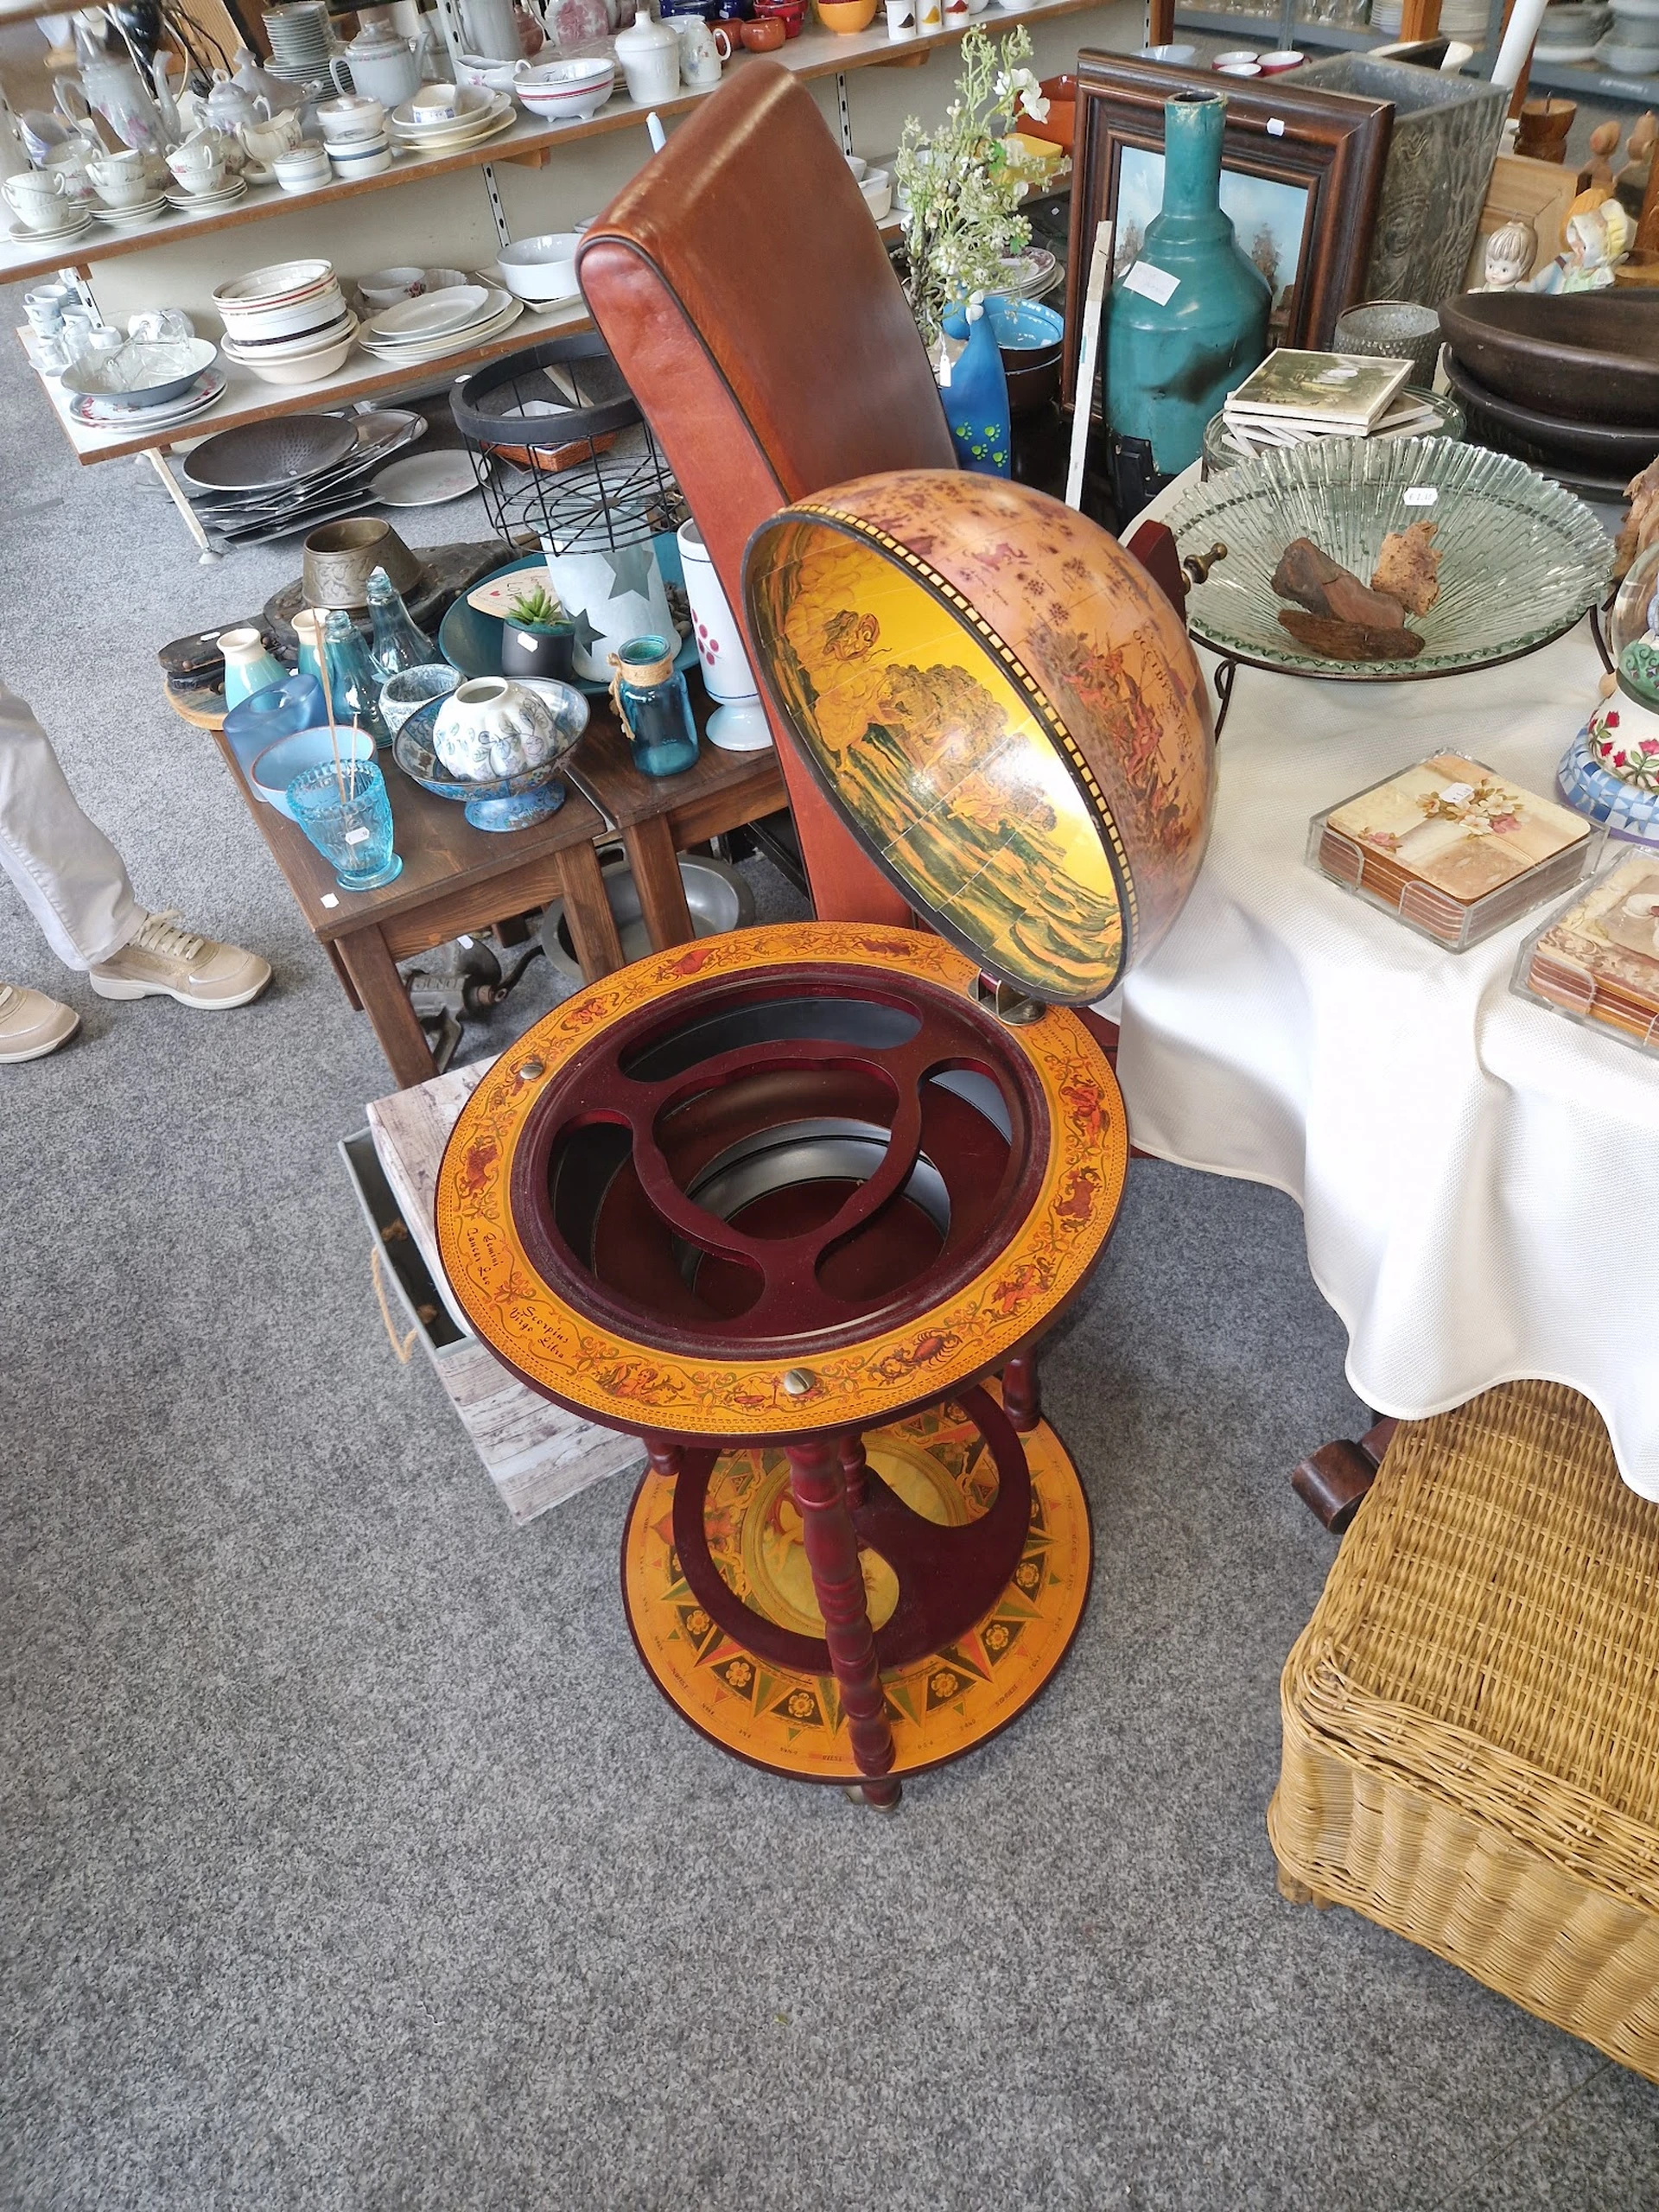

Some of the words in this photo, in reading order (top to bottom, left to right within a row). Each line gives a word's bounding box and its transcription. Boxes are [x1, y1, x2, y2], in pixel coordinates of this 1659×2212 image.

[467, 1228, 481, 1264] Cancer
[478, 1266, 491, 1286] Leo
[483, 1232, 505, 1267] Gemini
[510, 1306, 533, 1333] Virgo
[537, 1337, 565, 1359] Libra
[521, 1306, 570, 1344] Scorpius
